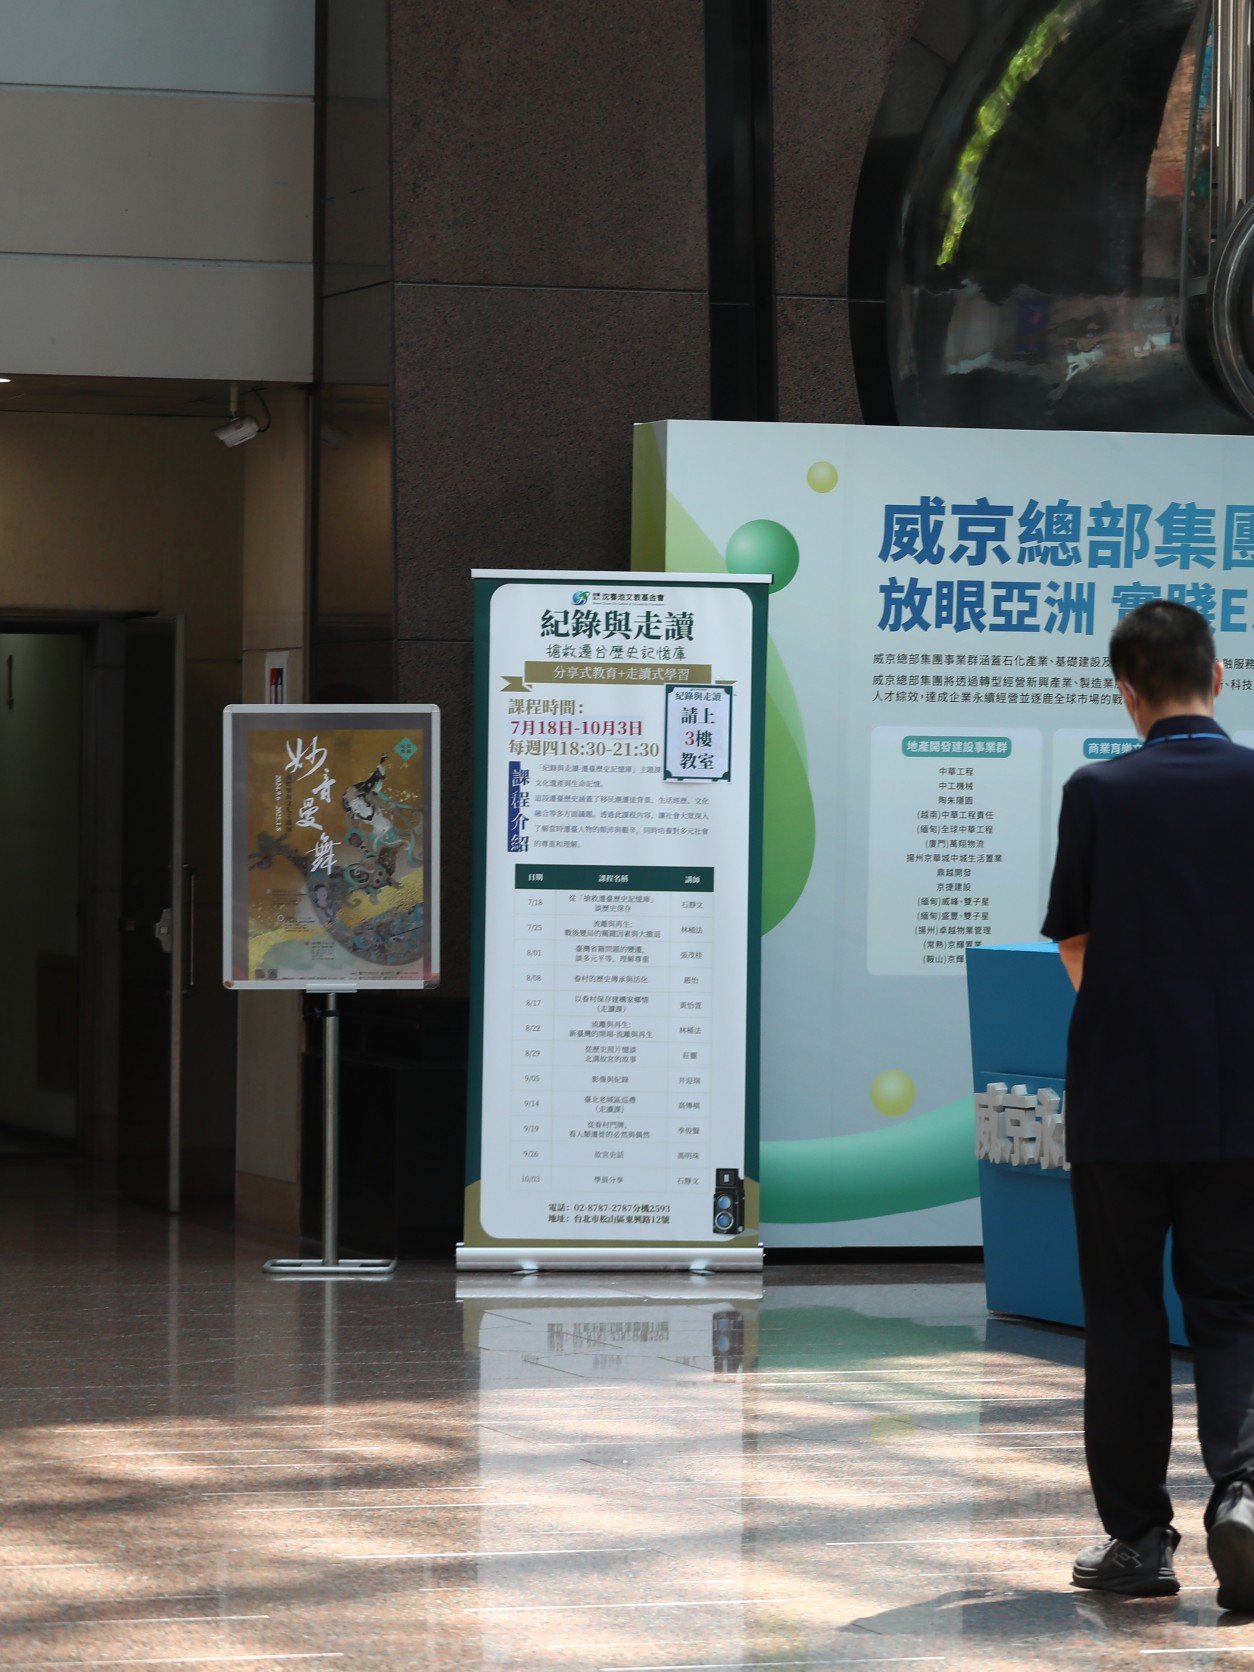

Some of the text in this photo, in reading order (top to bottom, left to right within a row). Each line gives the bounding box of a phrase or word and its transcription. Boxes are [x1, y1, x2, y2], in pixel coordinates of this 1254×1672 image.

[878, 576, 1096, 636] 放眼亞洲
[540, 609, 694, 641] 紀錄與走讀
[546, 644, 687, 661] 搶救遷台歷史記憶庫
[553, 666, 690, 682] 分享式教育+走讀式學習
[675, 691, 722, 702] 紀錄與走讀
[681, 707, 715, 725] 請上
[510, 720, 643, 736] 7月18日-10月3日
[684, 730, 712, 747] 3樓
[907, 740, 1008, 753] 地產開發建設事業群
[508, 739, 660, 757] 每週四18:30-21:30
[680, 752, 714, 770] 教室
[939, 767, 974, 776] 中華工程
[939, 782, 974, 790] 中工機械
[510, 768, 530, 852] 課程介紹
[917, 810, 994, 820] (越南)中華工程責任
[917, 825, 993, 834] (緬甸)全球中華工程
[915, 926, 991, 935] (揚州)卓越物業管理
[923, 954, 964, 964] (鞍山)京輝
